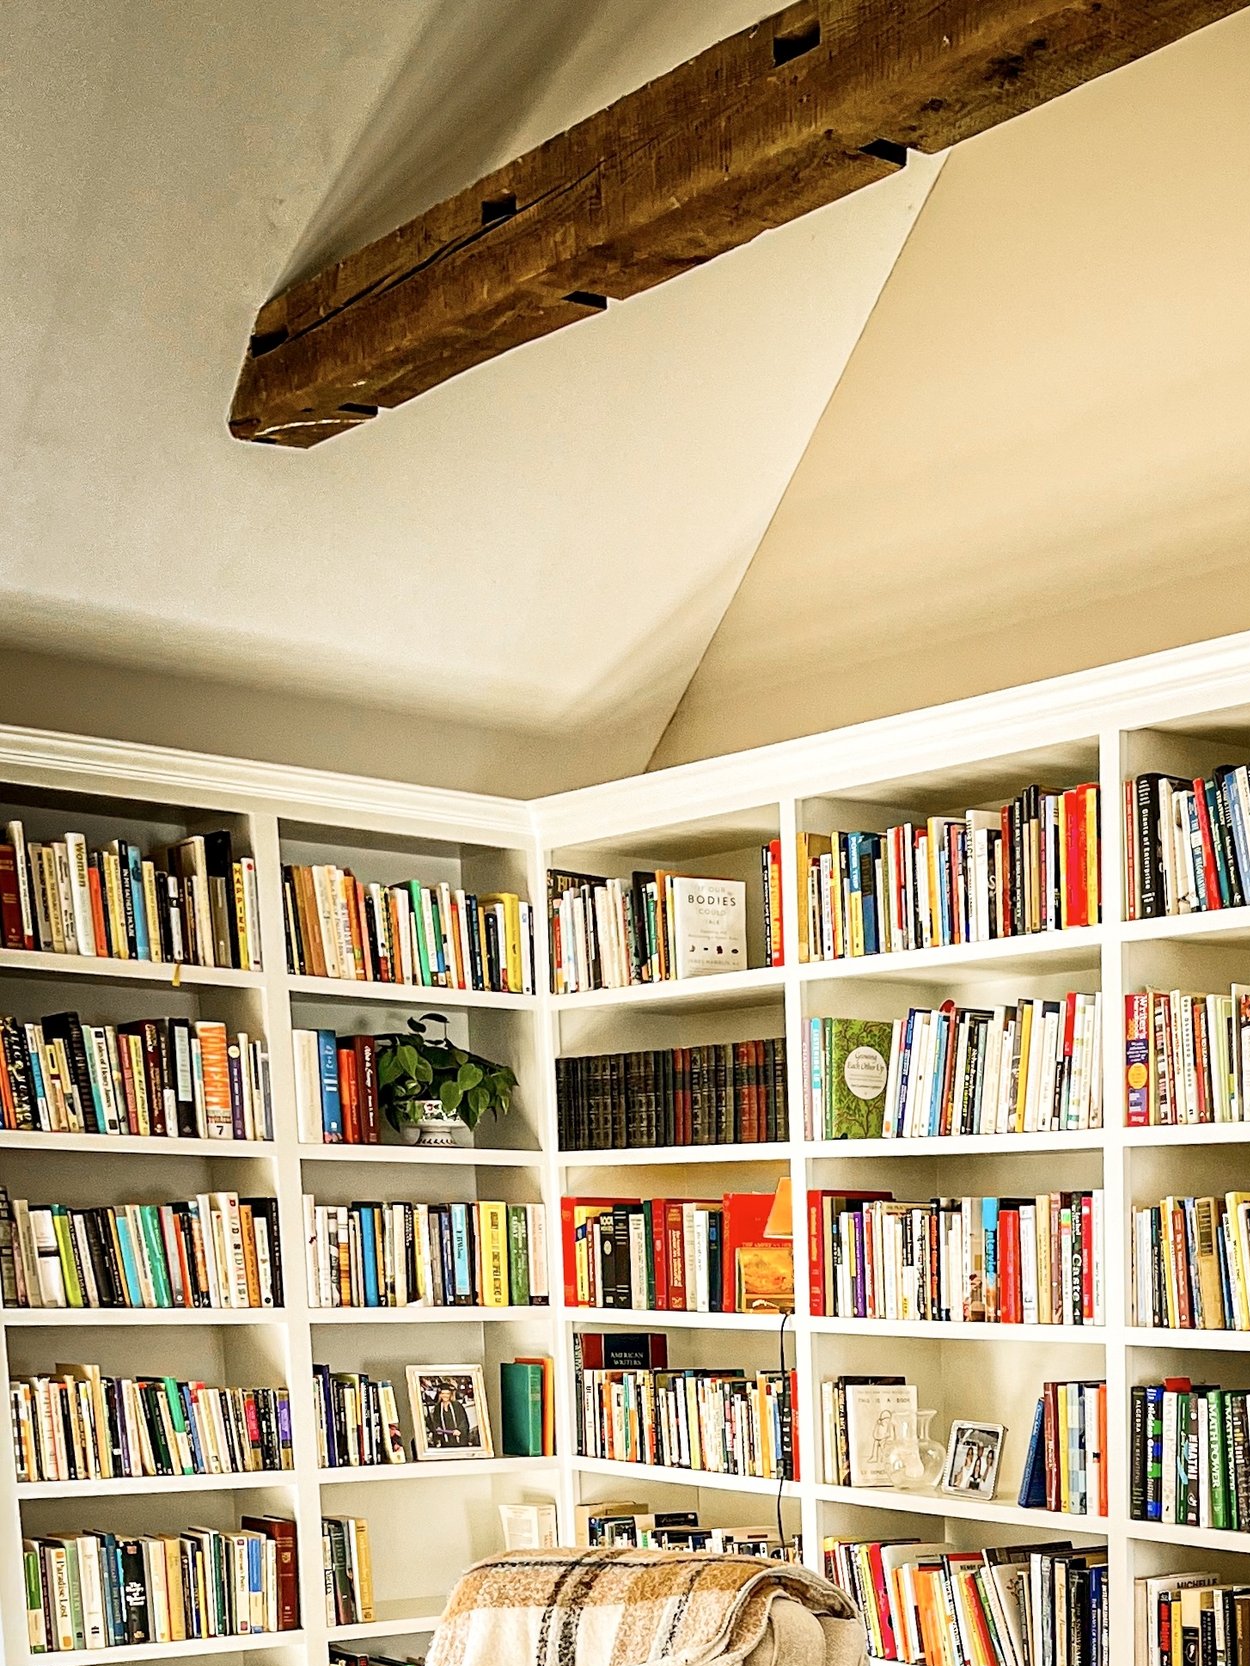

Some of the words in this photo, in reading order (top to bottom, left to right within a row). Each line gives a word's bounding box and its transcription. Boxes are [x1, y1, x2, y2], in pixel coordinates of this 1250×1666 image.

[75, 843, 86, 888] Woman
[688, 895, 736, 907] BODIES
[199, 1027, 228, 1110] VONNEGUT
[1072, 1254, 1081, 1302] Caste
[611, 1351, 643, 1359] AMERICAN
[1209, 1404, 1218, 1442] MATH
[1211, 1444, 1220, 1488] POWER
[56, 1561, 68, 1597] Paradise
[60, 1599, 68, 1618] Lost
